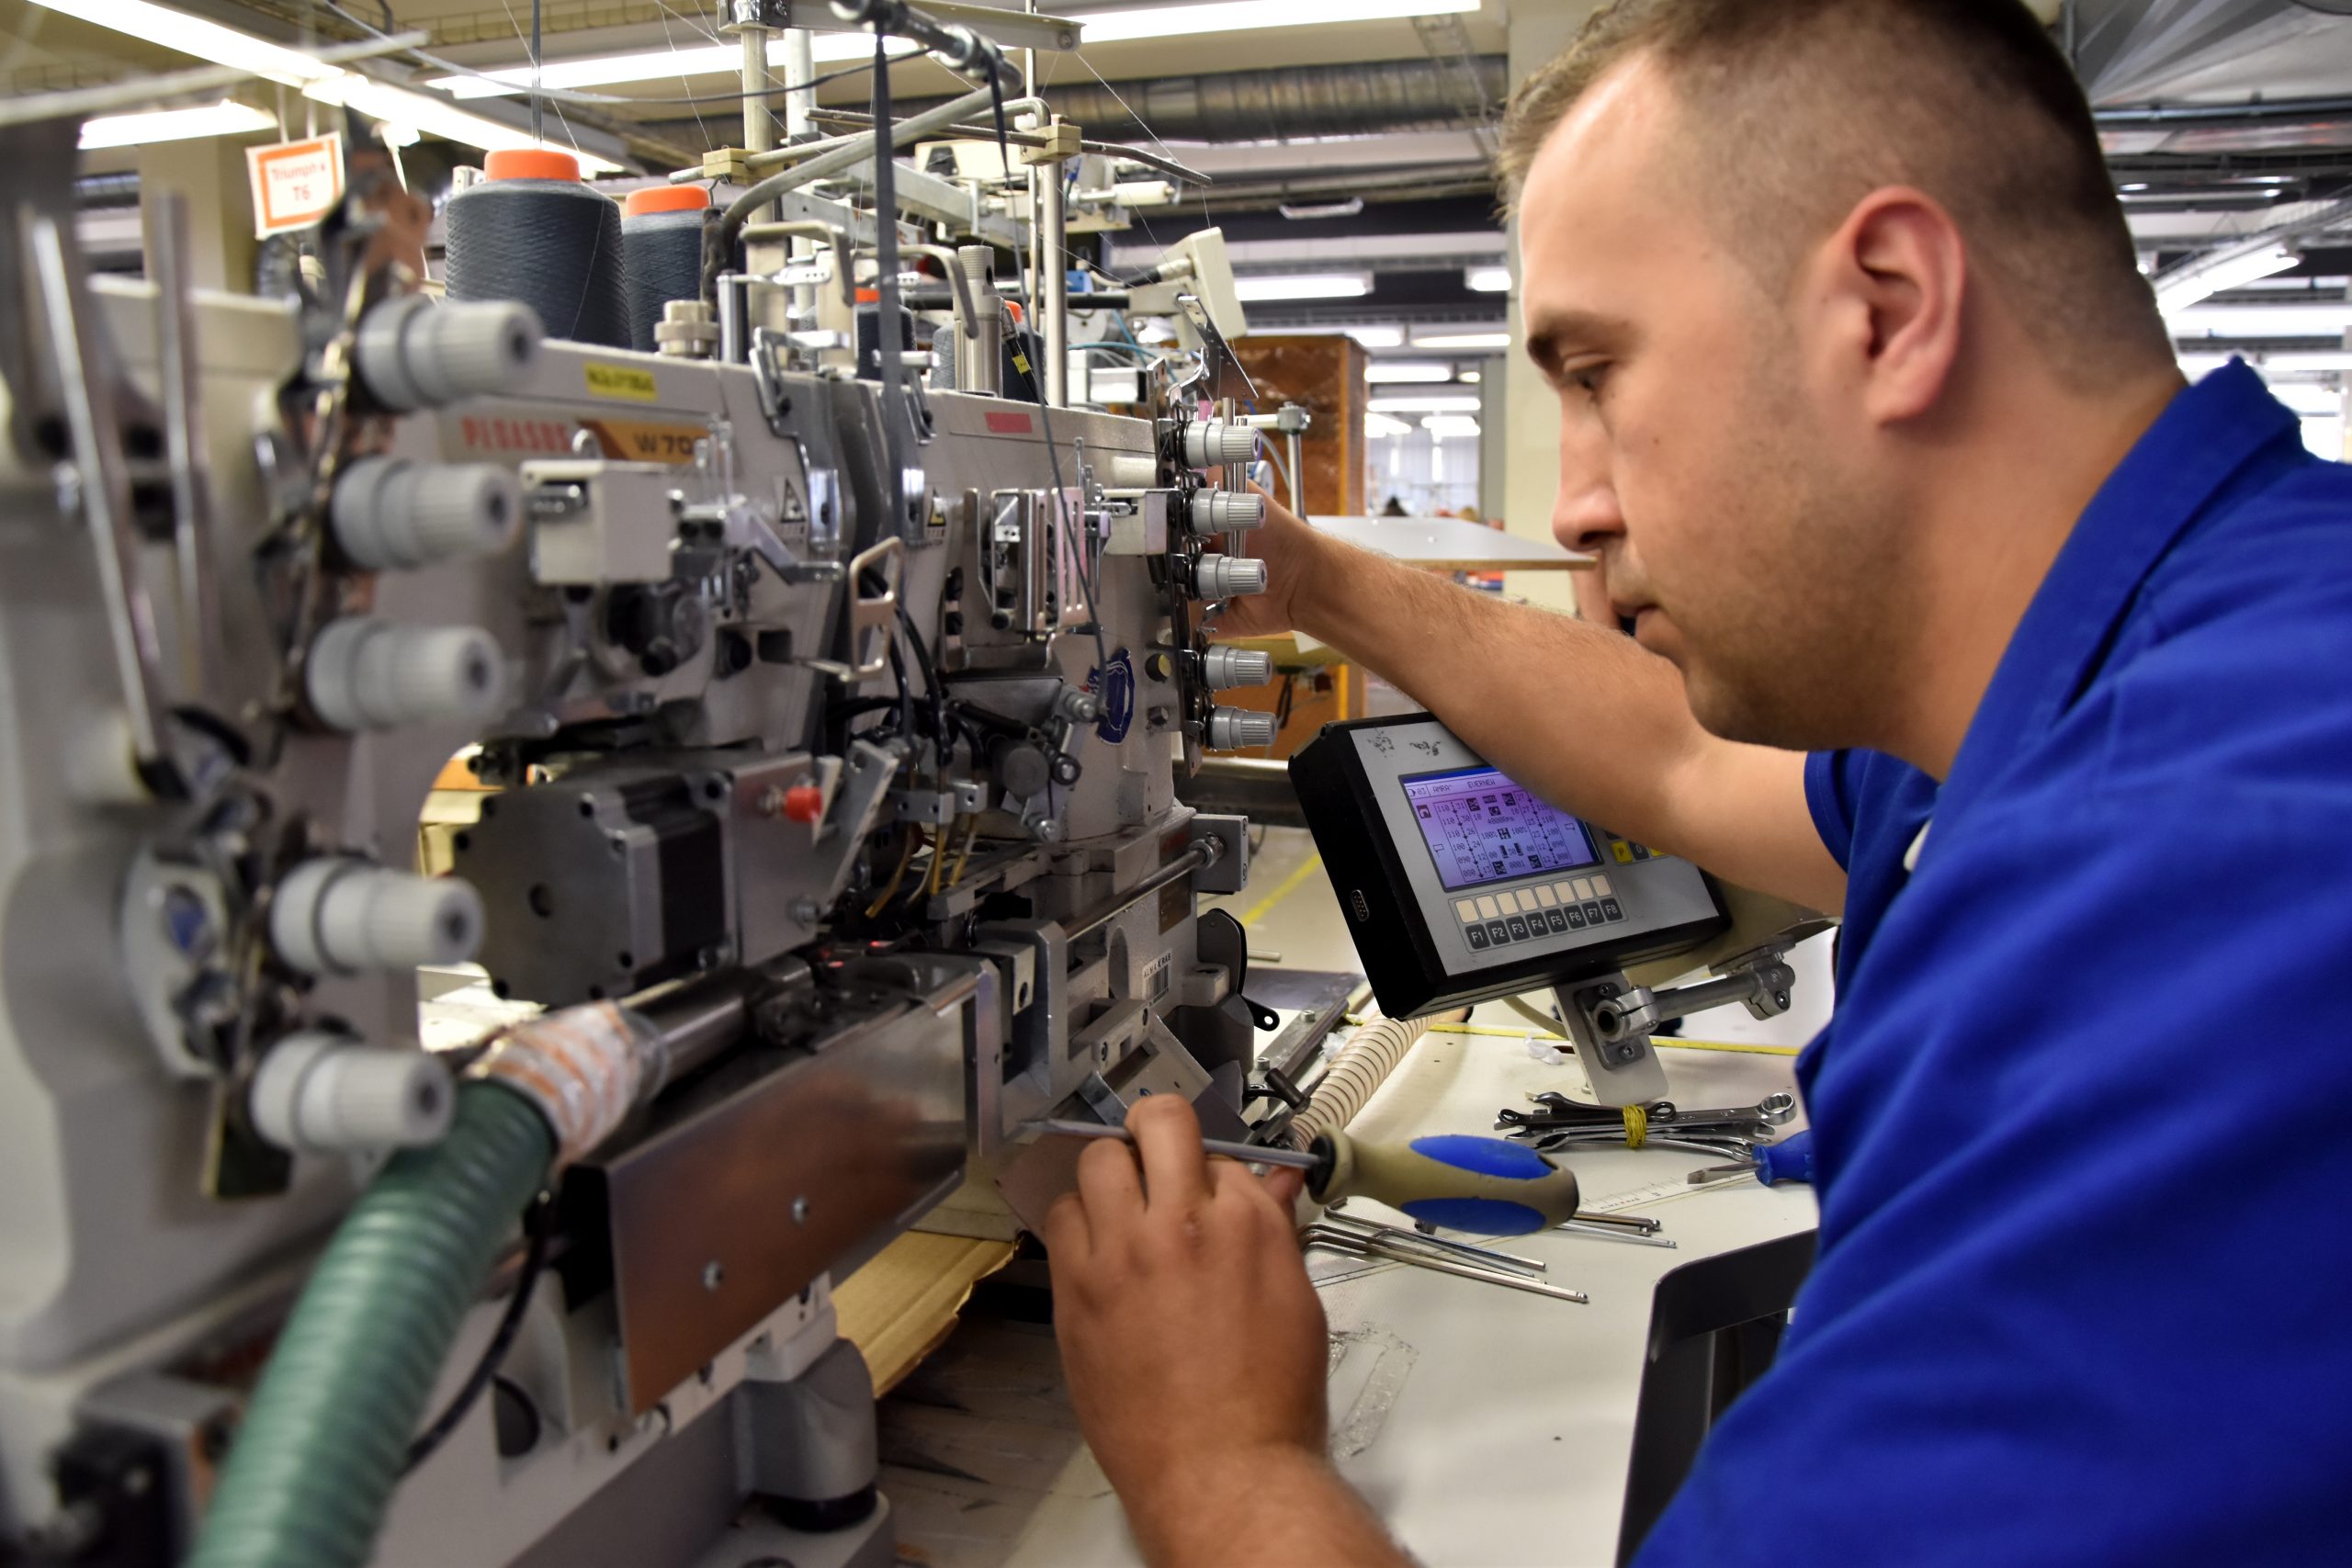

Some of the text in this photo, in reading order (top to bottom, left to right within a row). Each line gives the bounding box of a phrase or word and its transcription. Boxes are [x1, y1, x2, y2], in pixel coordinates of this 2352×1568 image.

[272, 164, 316, 181] Triumph
[1471, 905, 1618, 942] F1 F2 F3 F4 F5 F6 F7 F8
